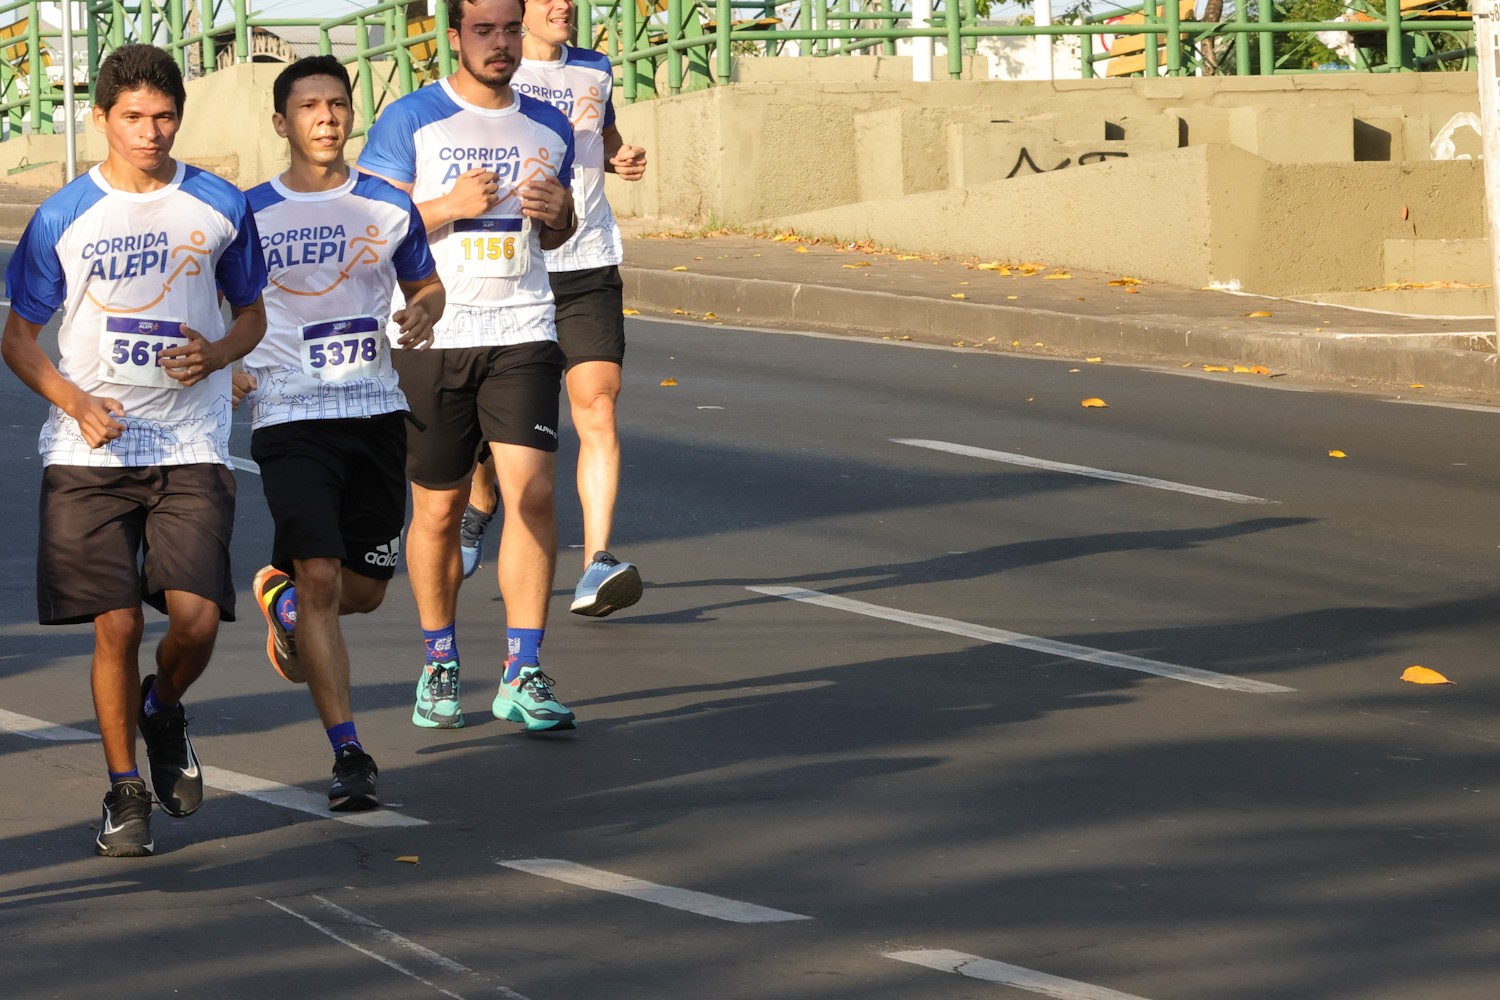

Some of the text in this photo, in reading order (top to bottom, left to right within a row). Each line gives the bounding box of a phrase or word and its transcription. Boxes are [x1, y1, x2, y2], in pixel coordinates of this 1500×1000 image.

[510, 83, 574, 98] CORRIDA
[439, 146, 520, 161] CORRIDA
[82, 231, 168, 260] CORRIDA
[260, 224, 346, 250] CORRIDA
[461, 236, 515, 260] 1156
[86, 249, 168, 282] ALEPI
[267, 240, 346, 273] ALEPI
[310, 338, 376, 368] 5378
